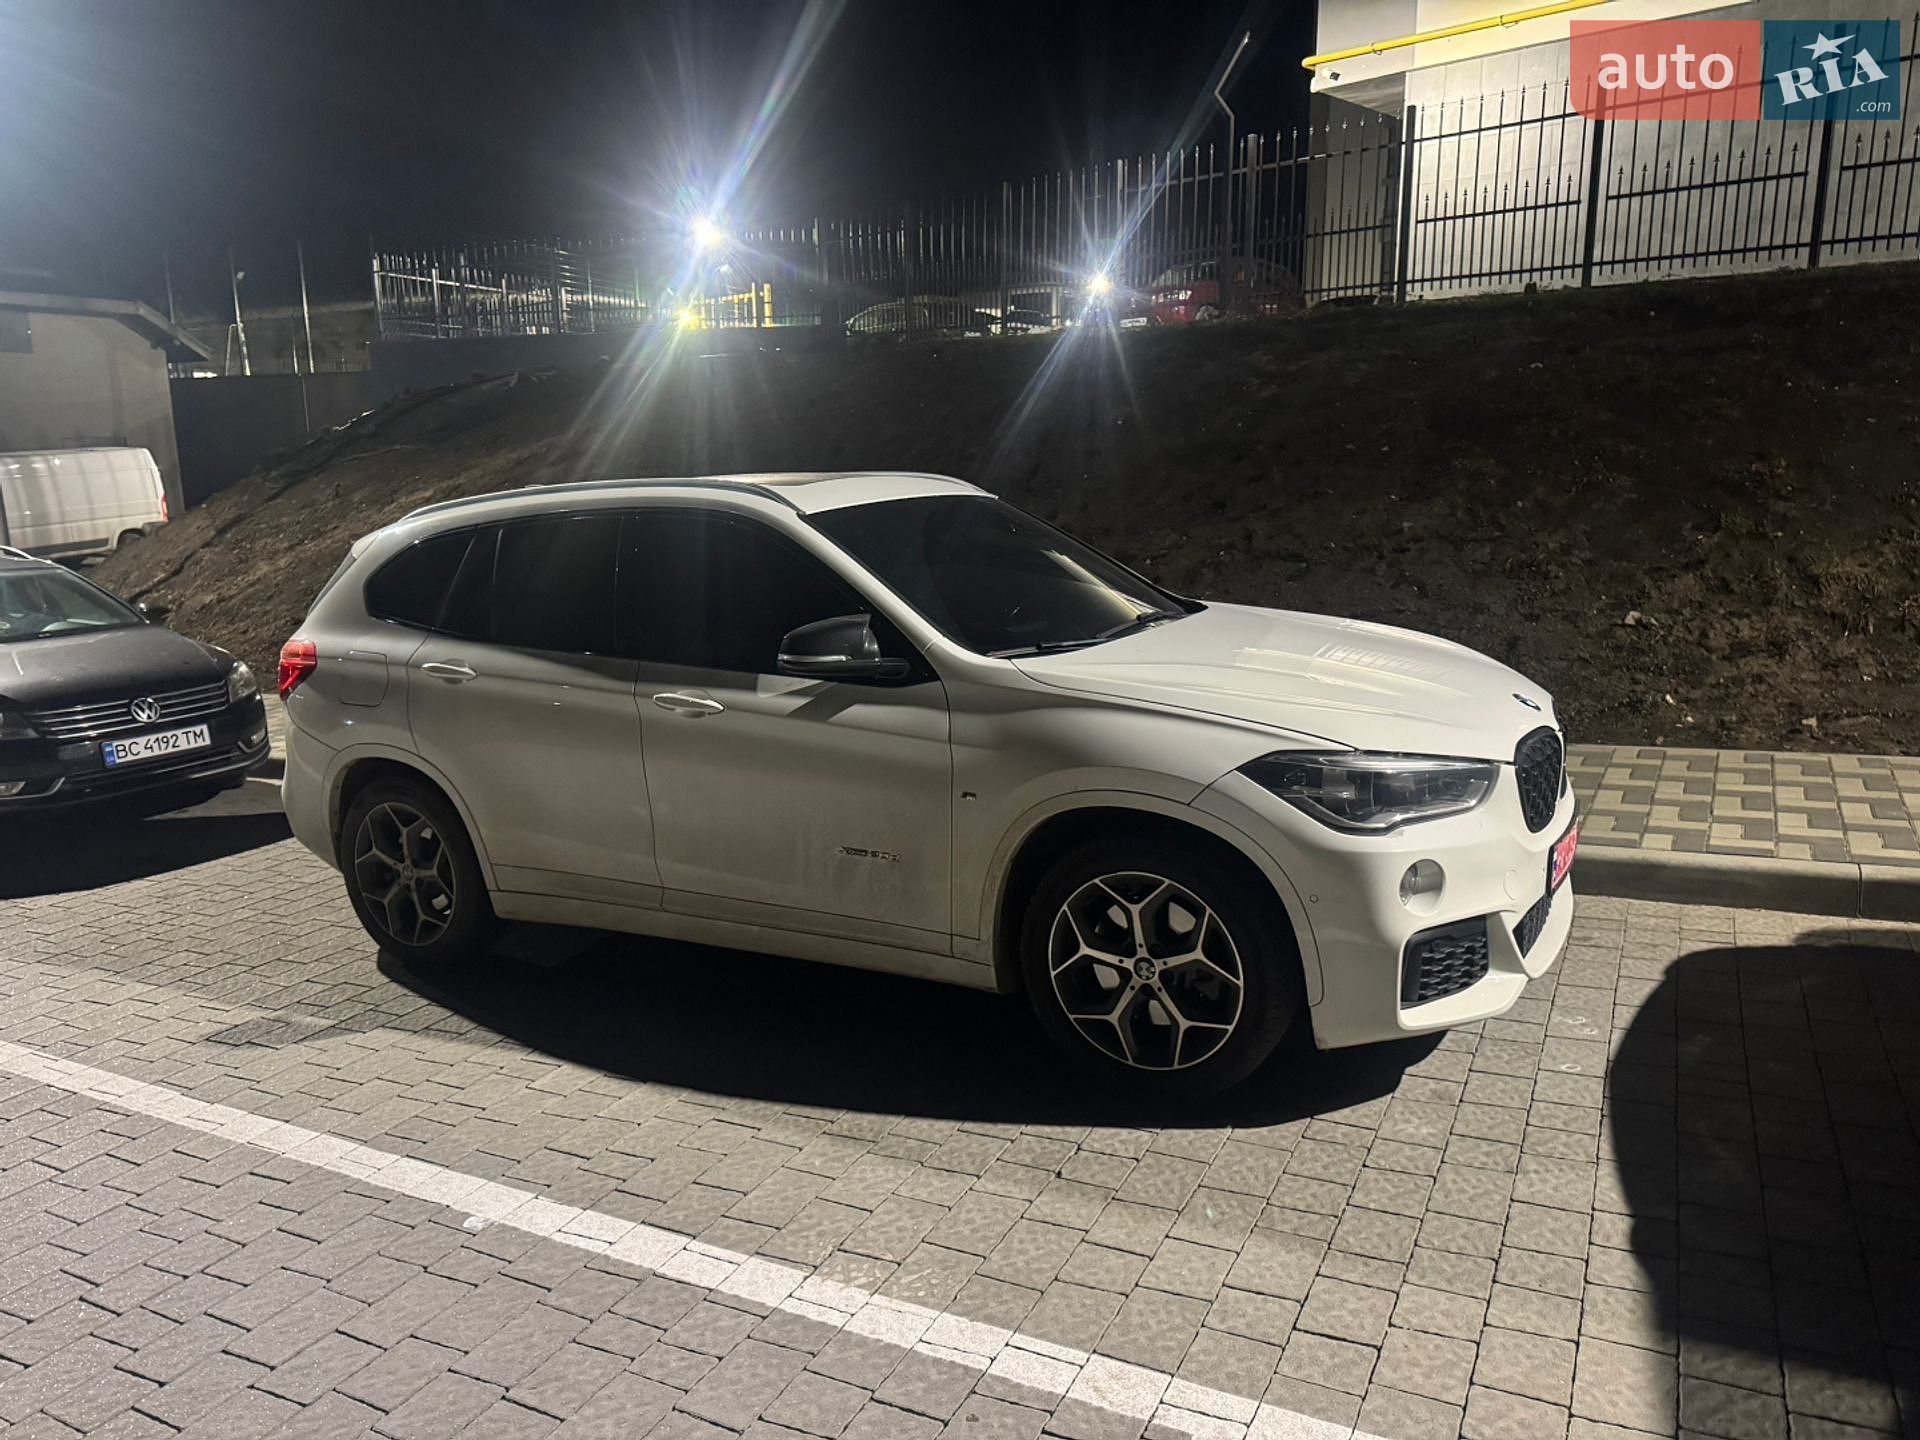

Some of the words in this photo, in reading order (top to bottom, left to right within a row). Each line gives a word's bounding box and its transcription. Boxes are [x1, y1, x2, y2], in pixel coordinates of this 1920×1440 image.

[115, 741, 141, 759] BC
[144, 733, 180, 753] 4192
[181, 729, 206, 745] TM
